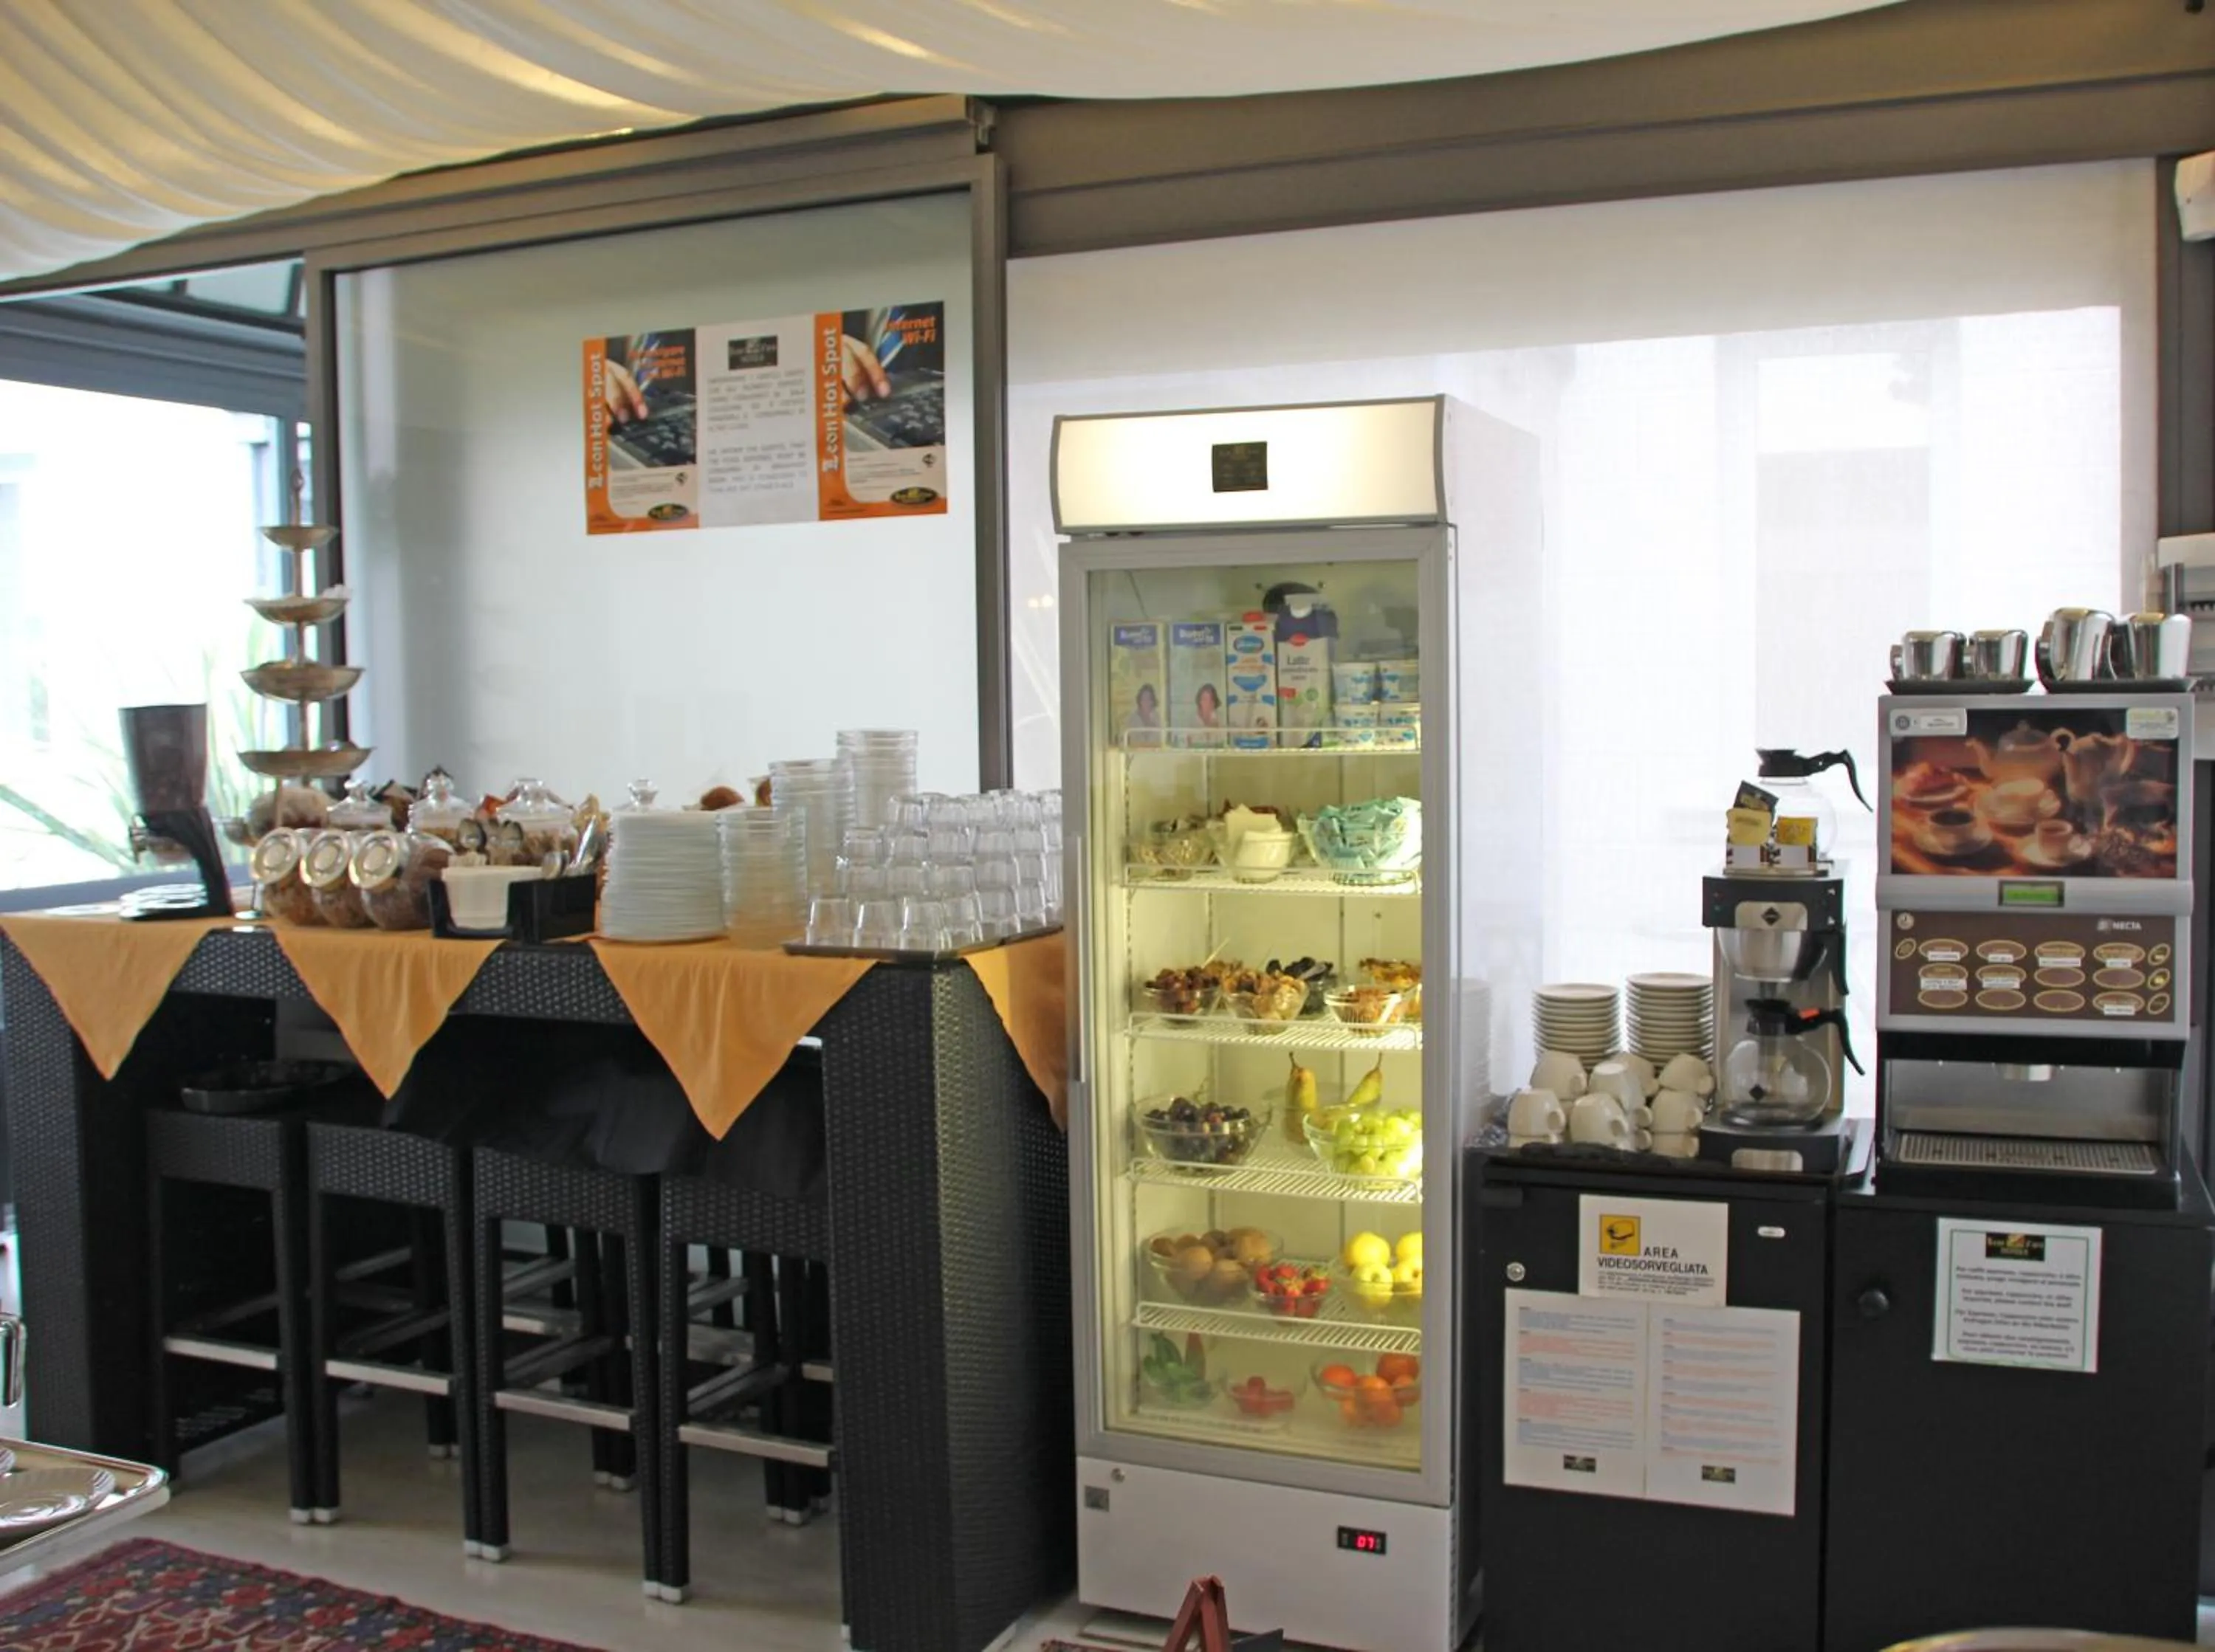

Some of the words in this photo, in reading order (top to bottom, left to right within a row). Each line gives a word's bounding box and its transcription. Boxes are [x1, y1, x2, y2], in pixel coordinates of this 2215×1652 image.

[886, 317, 935, 331] Internet
[902, 329, 935, 345] Wi-Fi
[821, 328, 840, 375] Spot
[588, 351, 604, 397] Spot
[1644, 1247, 1679, 1259] AREA
[1598, 1257, 1709, 1275] VIDEOSORVEGLIATA
